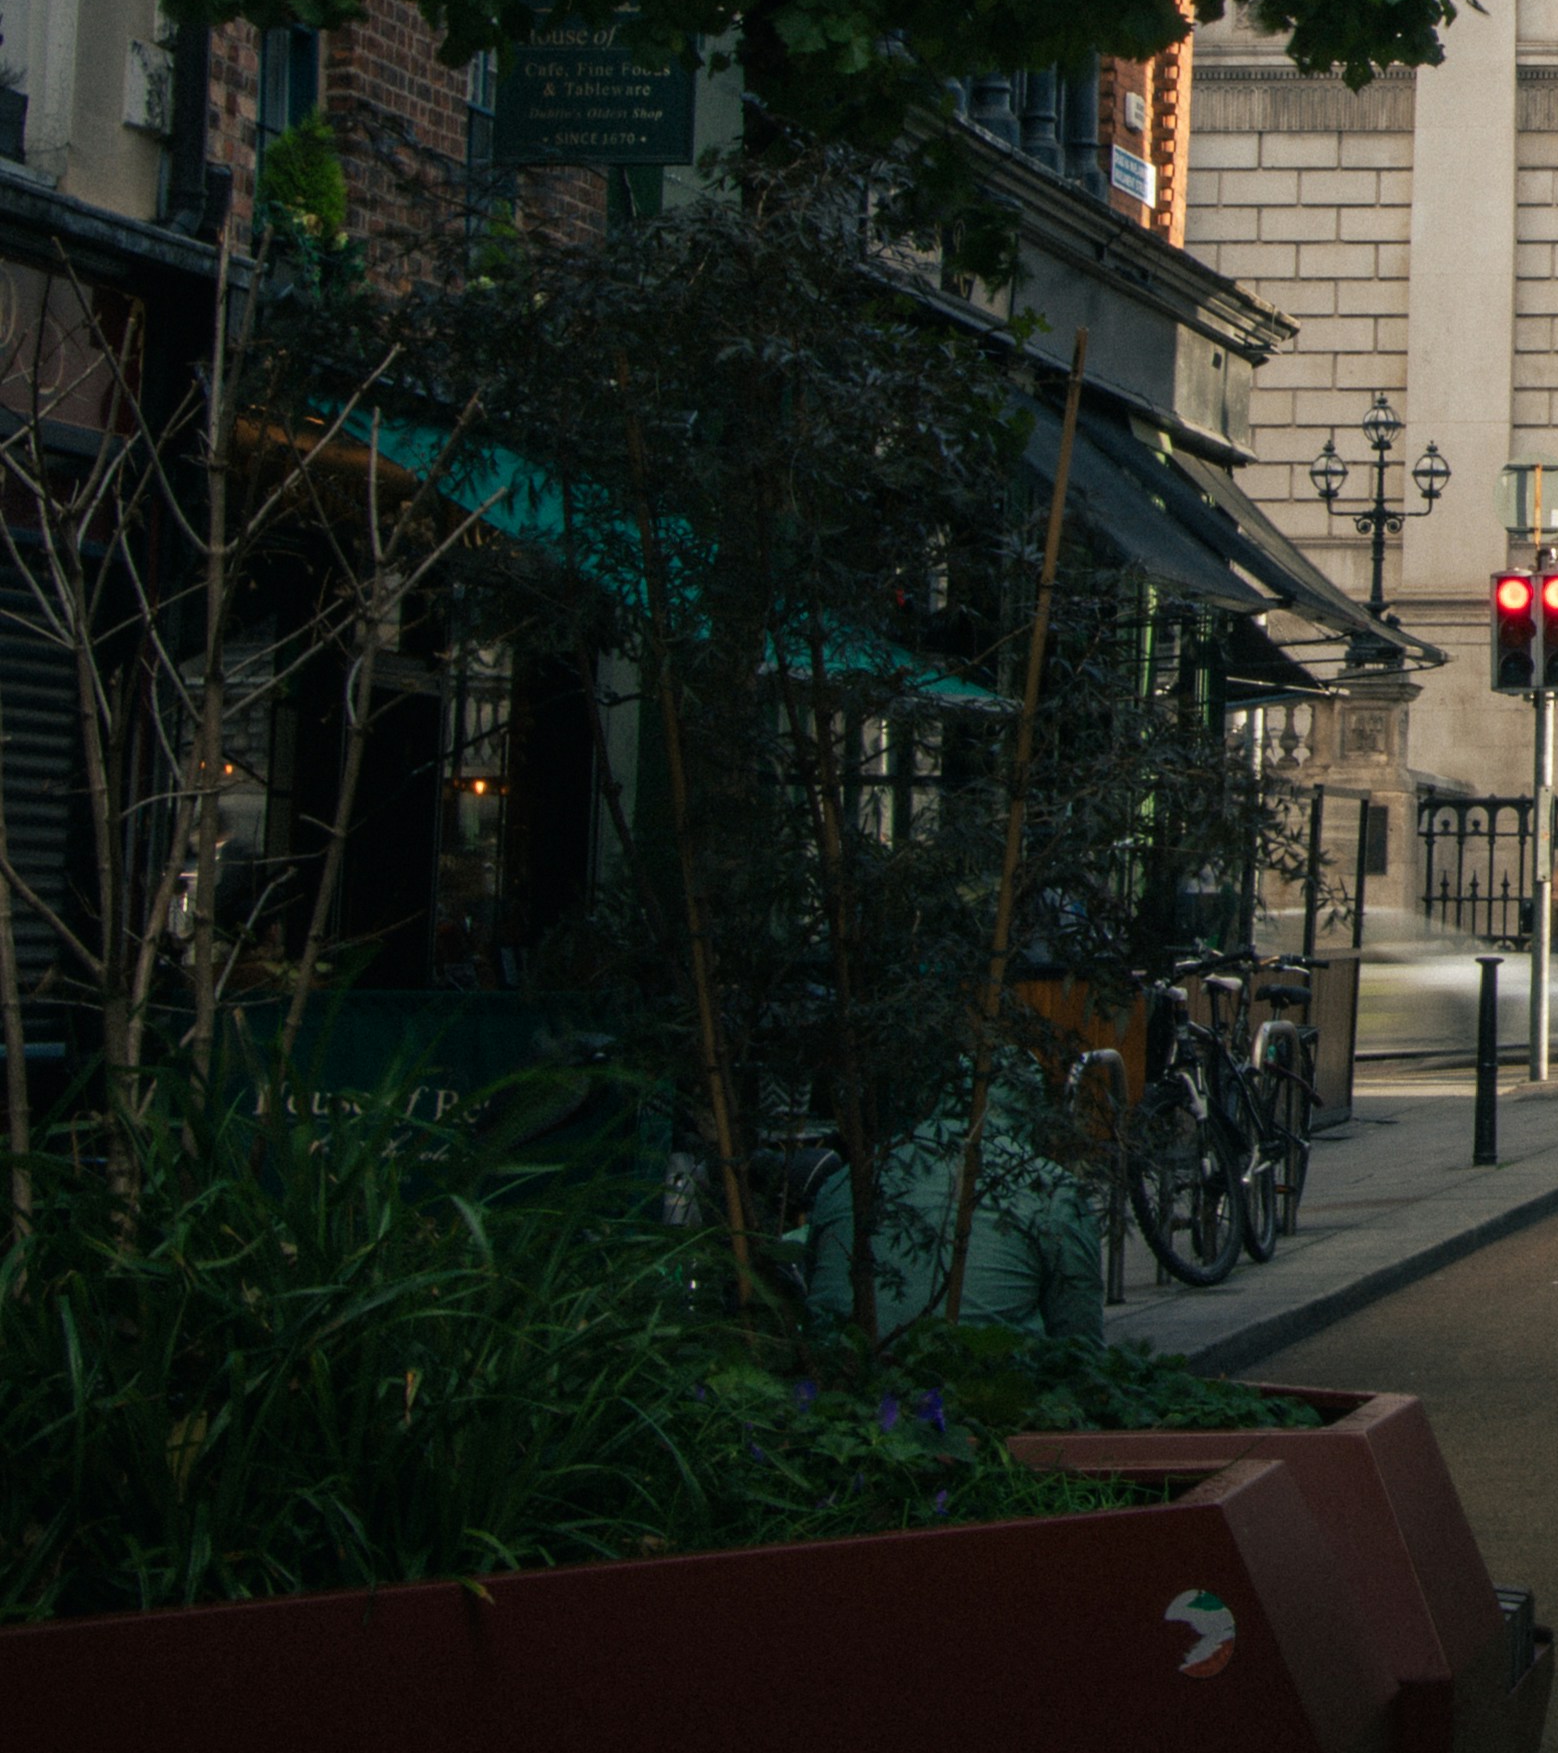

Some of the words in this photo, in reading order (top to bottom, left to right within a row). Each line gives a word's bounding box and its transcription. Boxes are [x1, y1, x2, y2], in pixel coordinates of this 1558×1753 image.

[593, 23, 621, 50] of
[577, 61, 613, 76] Fine
[621, 62, 671, 76] Foos
[543, 81, 555, 96] &
[565, 81, 651, 96] Tableware
[631, 107, 662, 121] Shop
[554, 131, 597, 144] SINCE
[602, 131, 635, 144] 1670
